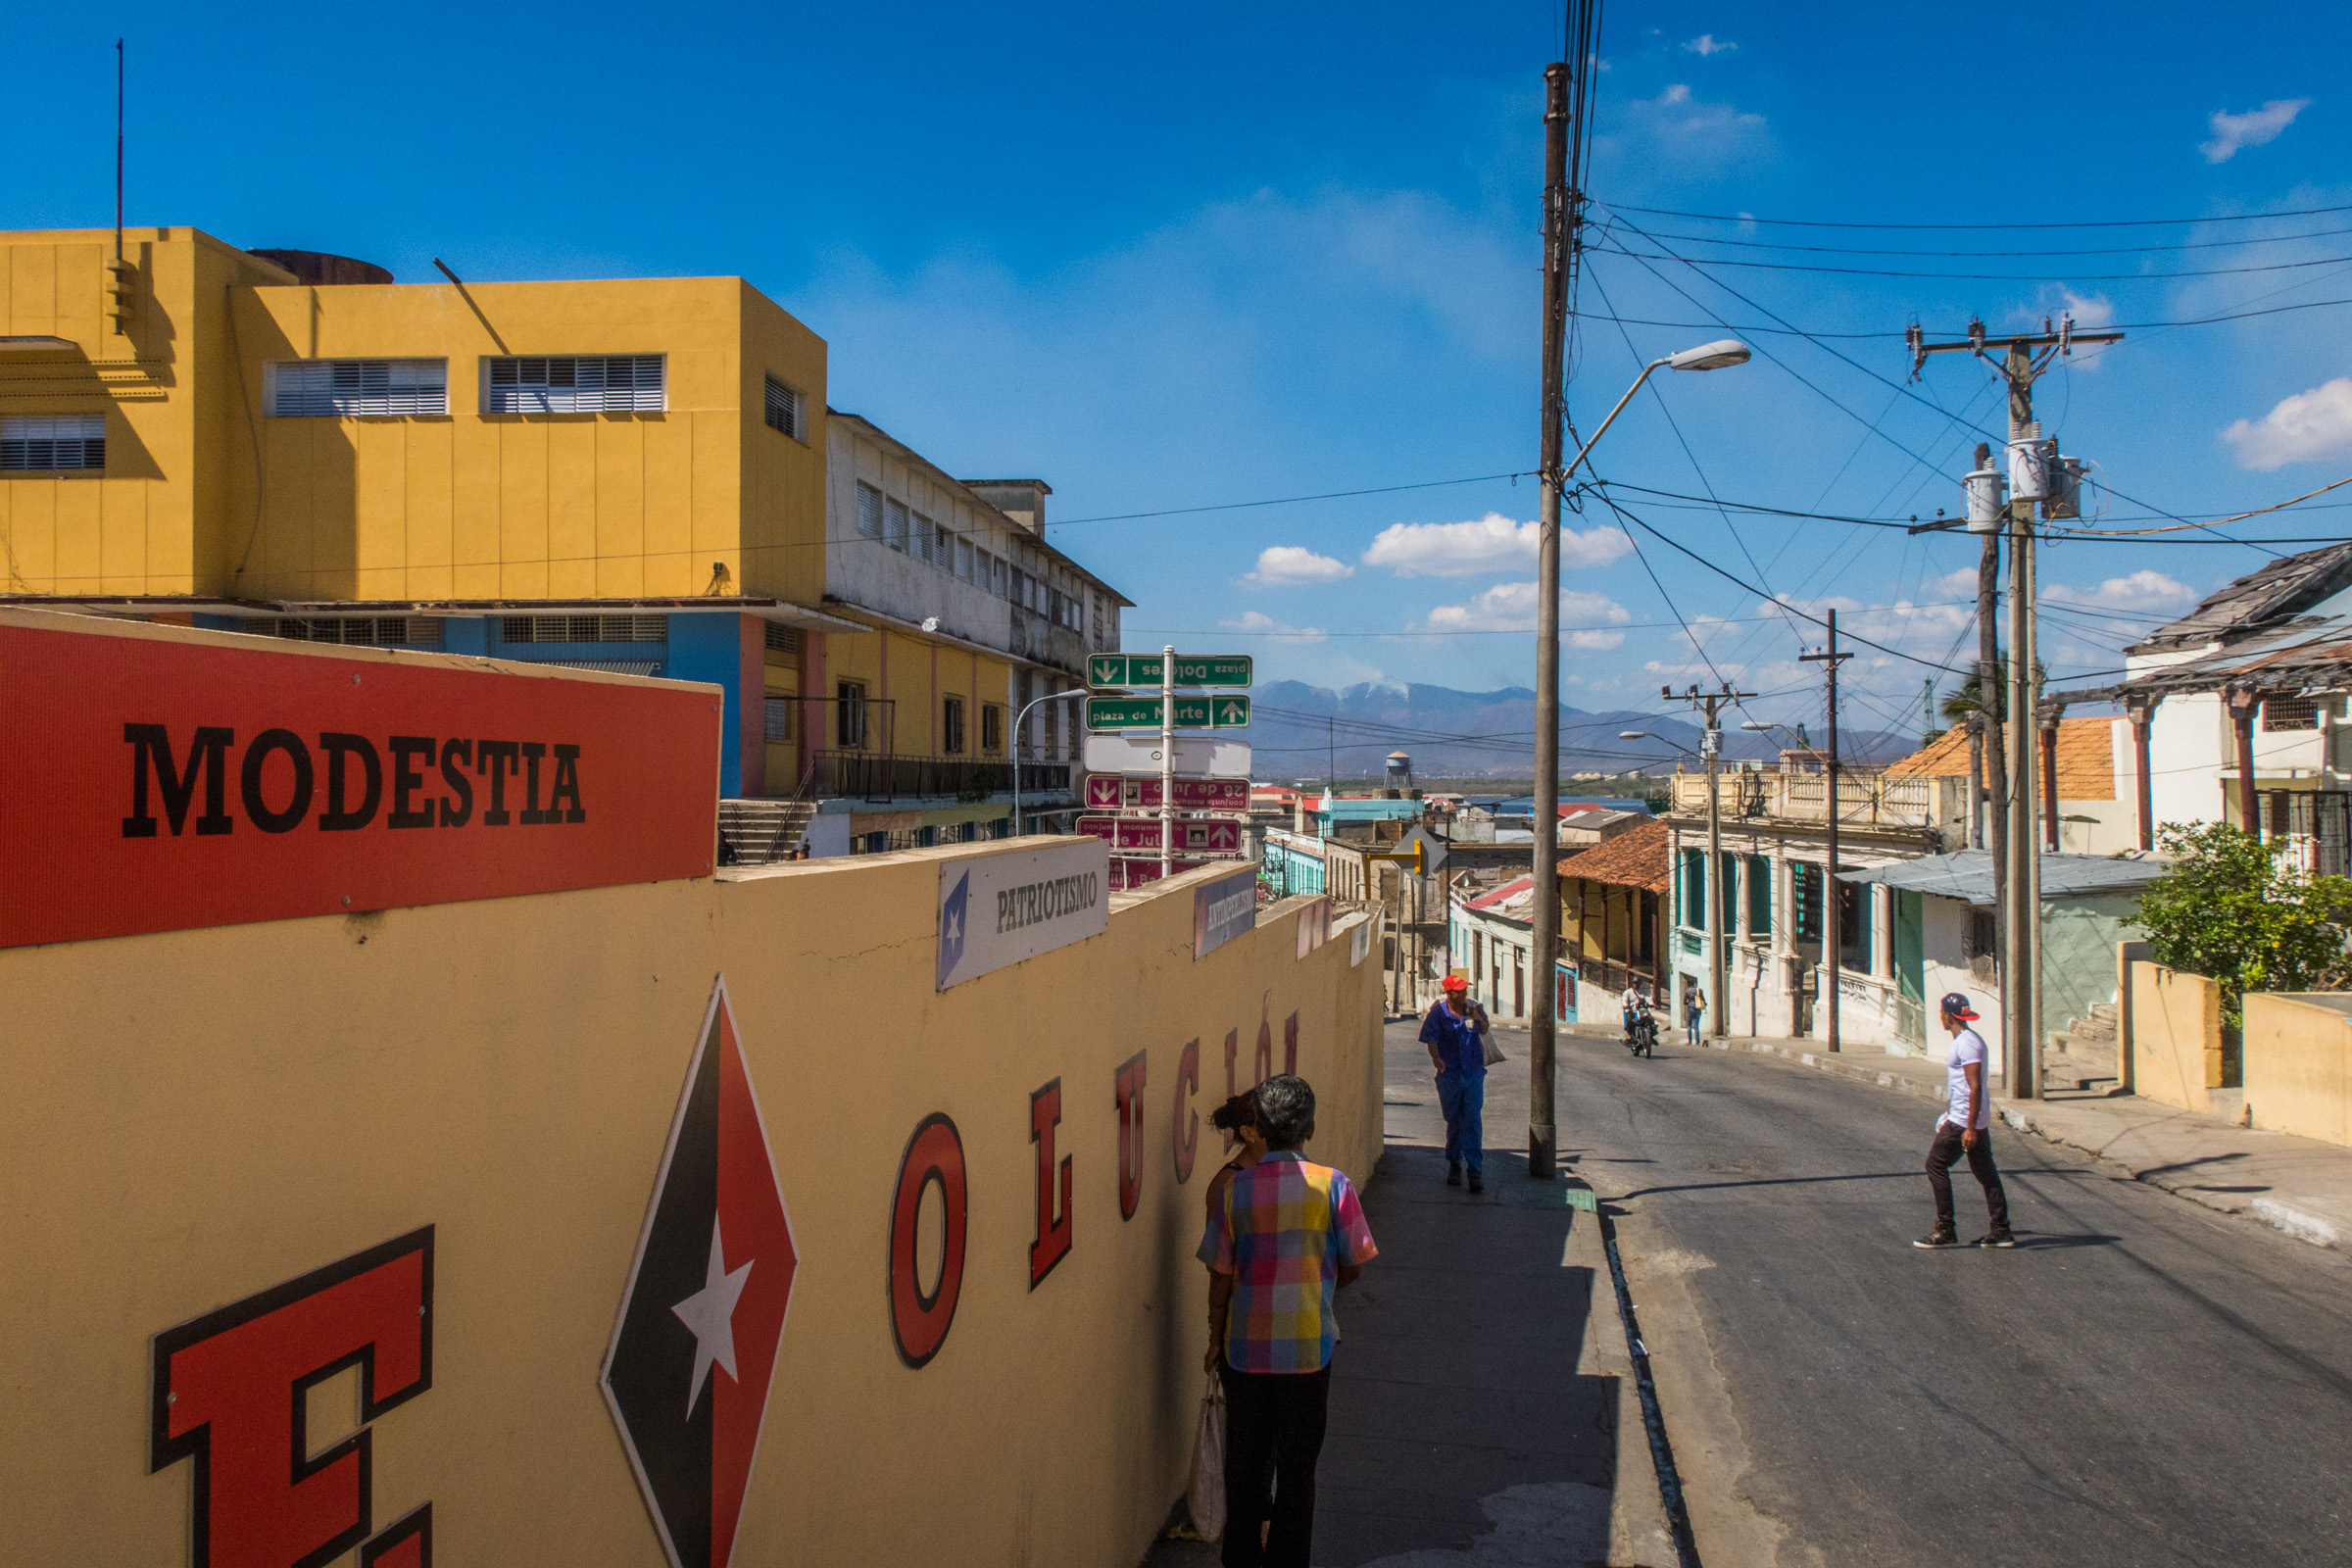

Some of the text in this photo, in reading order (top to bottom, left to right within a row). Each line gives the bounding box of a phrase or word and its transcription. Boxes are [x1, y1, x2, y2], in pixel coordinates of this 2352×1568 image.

[1215, 663, 1247, 673] plaza
[1093, 711, 1125, 723] plaza
[1132, 711, 1147, 720] de
[122, 723, 586, 838] MODESTIA
[1198, 783, 1217, 795] de
[1224, 785, 1244, 798] 26
[1206, 798, 1244, 808] conjunto
[997, 871, 1098, 934] PATRIOTISMO
